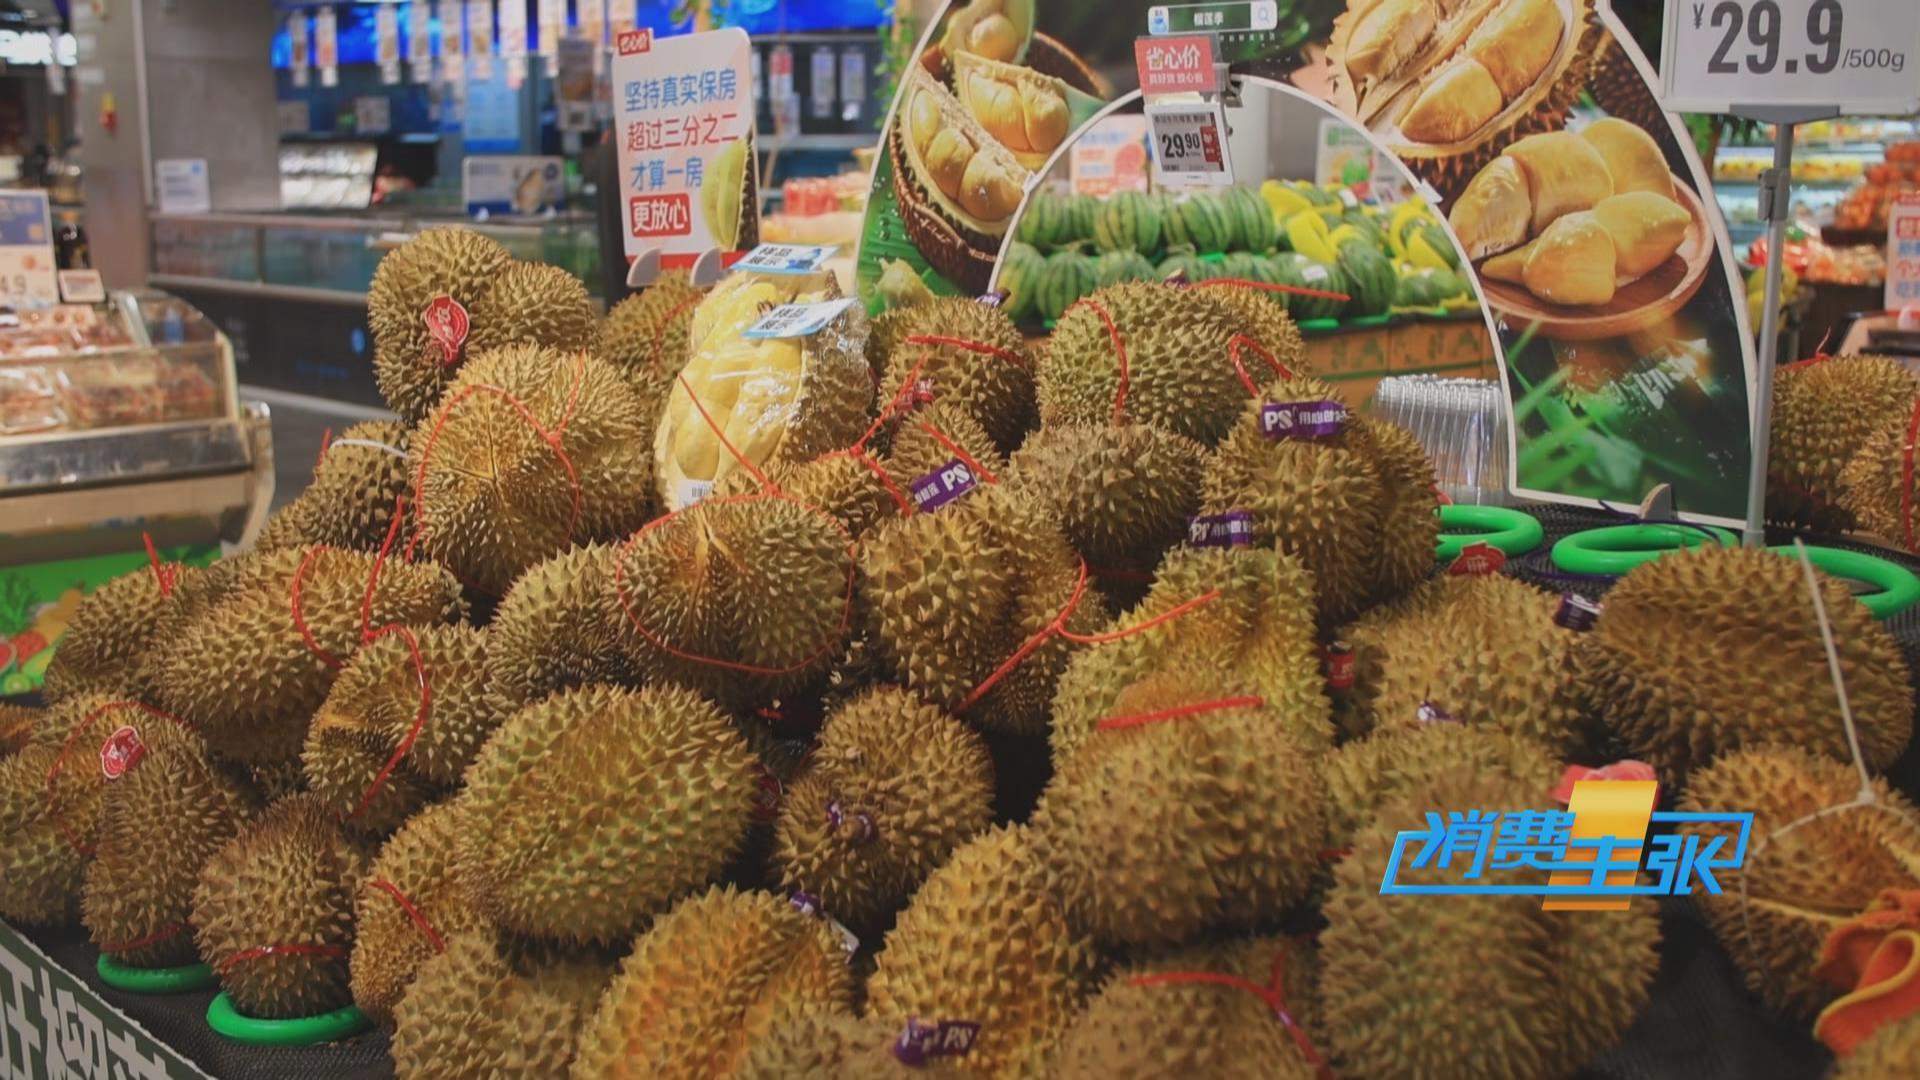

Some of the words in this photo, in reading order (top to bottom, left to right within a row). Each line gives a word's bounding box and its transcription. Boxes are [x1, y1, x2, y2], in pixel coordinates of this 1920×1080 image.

[1146, 44, 1201, 71] 省心价
[624, 68, 737, 112] 坚持真实保房
[627, 112, 739, 151] 超过三分之二
[631, 156, 704, 192] 才算一房
[632, 198, 689, 234] 更放心
[1264, 409, 1294, 431] PS
[940, 463, 970, 492] PS
